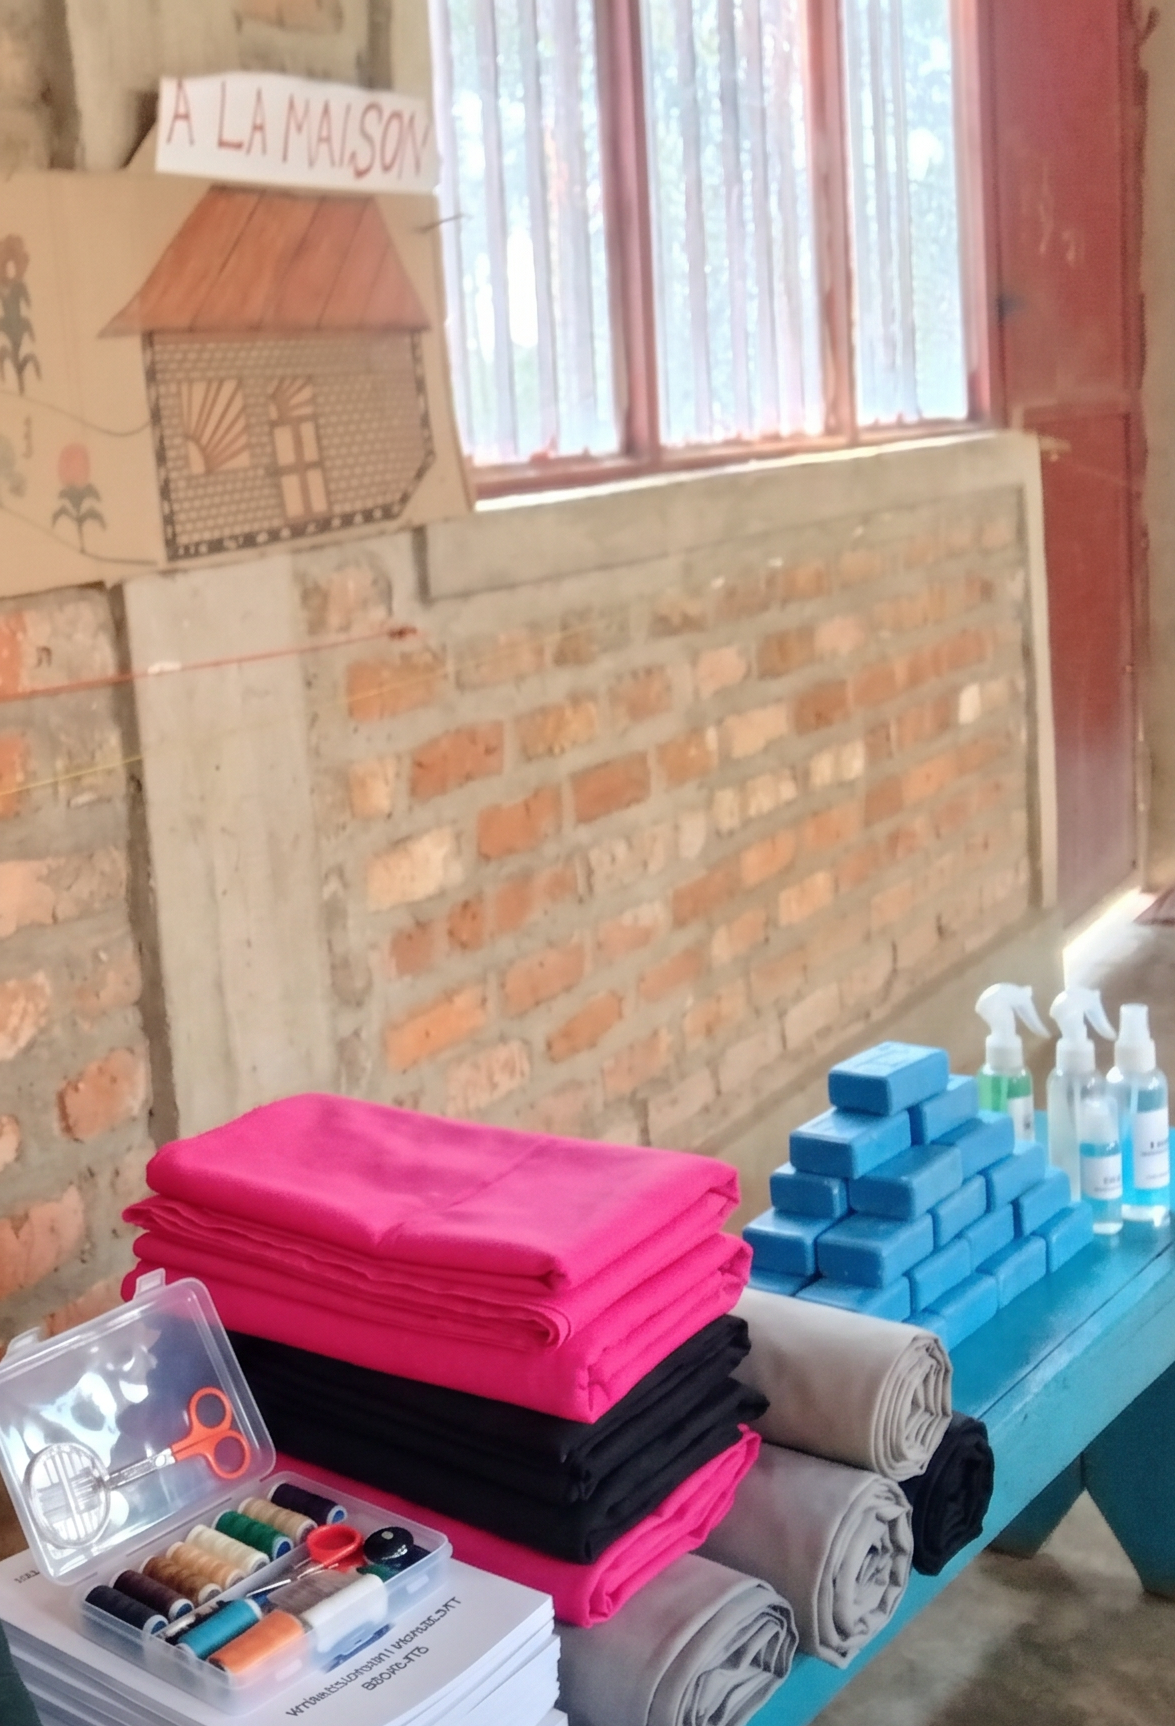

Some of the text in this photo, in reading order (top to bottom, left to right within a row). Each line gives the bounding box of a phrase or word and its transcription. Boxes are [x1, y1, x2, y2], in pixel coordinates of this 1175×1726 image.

[165, 77, 430, 180] A LA MAISON
